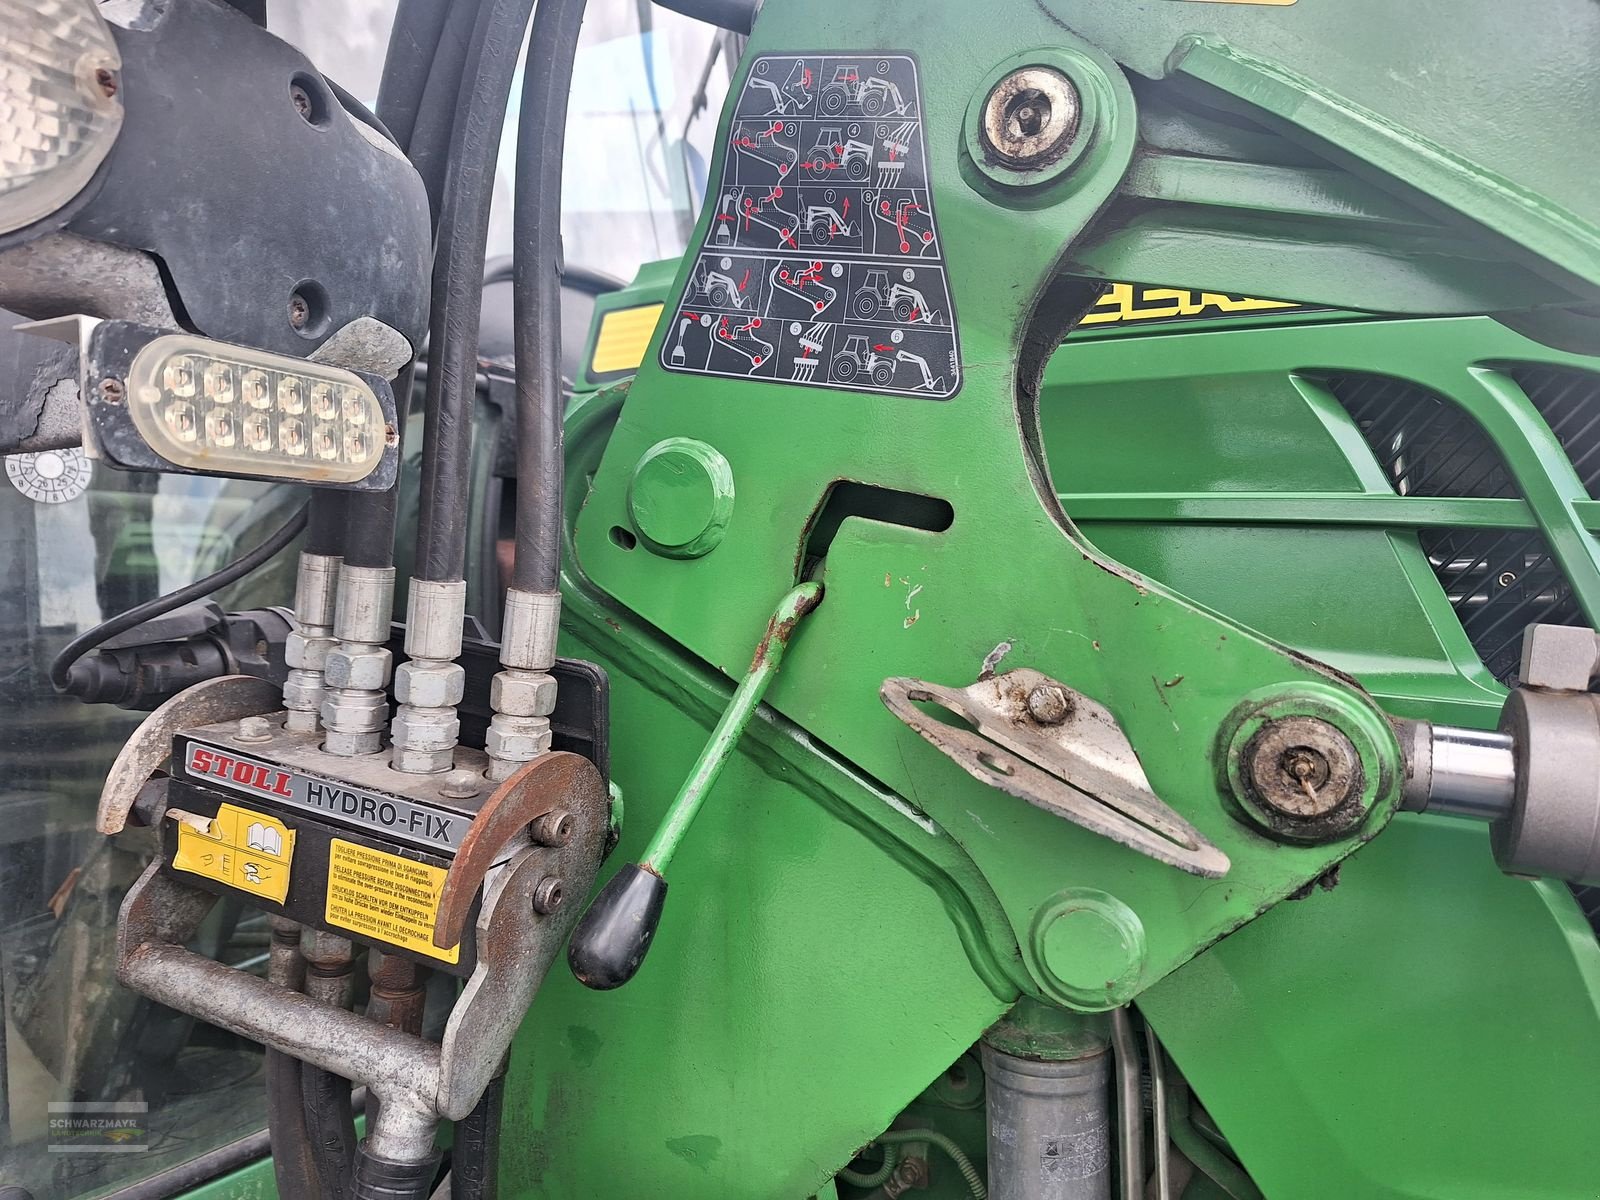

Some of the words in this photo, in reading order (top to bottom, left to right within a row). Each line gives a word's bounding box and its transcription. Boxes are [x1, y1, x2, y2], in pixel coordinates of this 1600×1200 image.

[191, 748, 293, 798] STOLL
[306, 781, 455, 843] HYDRO-FIX
[336, 845, 356, 856] TOGLIERE
[357, 850, 381, 864] PRESSIONE
[382, 858, 397, 868] PRIMA
[403, 864, 429, 878] SGANCIARE
[334, 864, 352, 875] RELEASE
[353, 869, 376, 883] PRESSURE
[377, 876, 394, 888] BEFORE
[395, 881, 431, 898] DISCONNECTION
[338, 874, 356, 884] eliminate
[364, 882, 392, 895] over-pressure
[406, 894, 433, 907] reconnection
[332, 884, 355, 896] DRUCKLOS
[356, 892, 378, 904] SCHALTEN
[400, 905, 428, 920] ENTKUPPELN
[344, 896, 353, 904] hohe
[369, 904, 379, 912] beim
[380, 907, 394, 917] wieder
[352, 920, 376, 932] surpression
[354, 911, 376, 924] PRESSION
[377, 919, 392, 928] AVANT
[399, 925, 429, 942] DECROCHAGE
